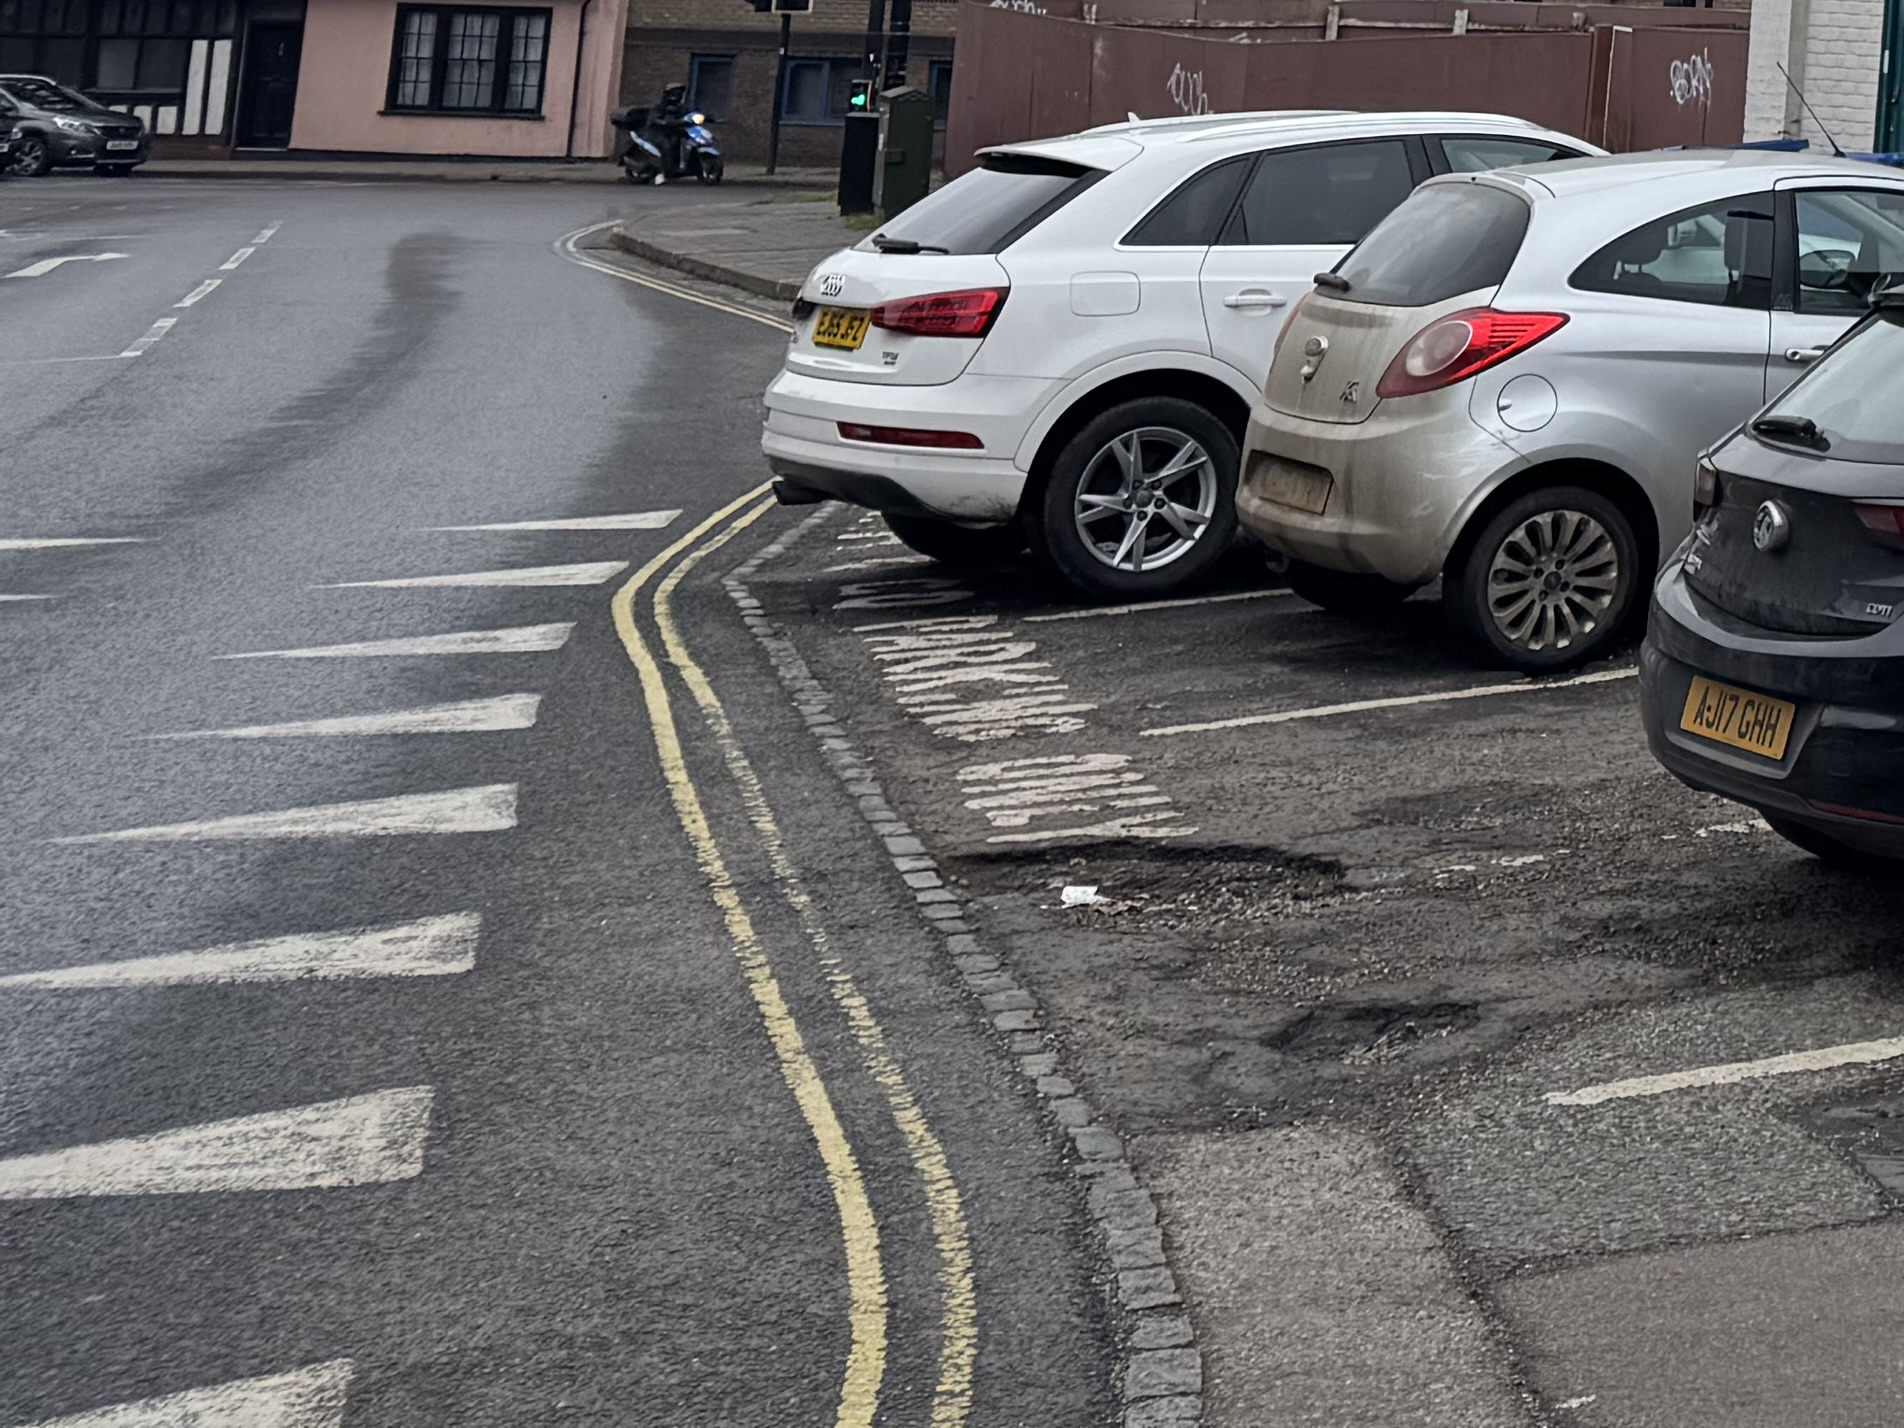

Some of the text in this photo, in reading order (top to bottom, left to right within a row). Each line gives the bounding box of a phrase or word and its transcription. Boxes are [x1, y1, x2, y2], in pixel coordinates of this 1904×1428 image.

[850, 615, 1099, 741] PARKING
[1693, 685, 1782, 749] AJ17 GHH
[956, 753, 1200, 843] ONLY
